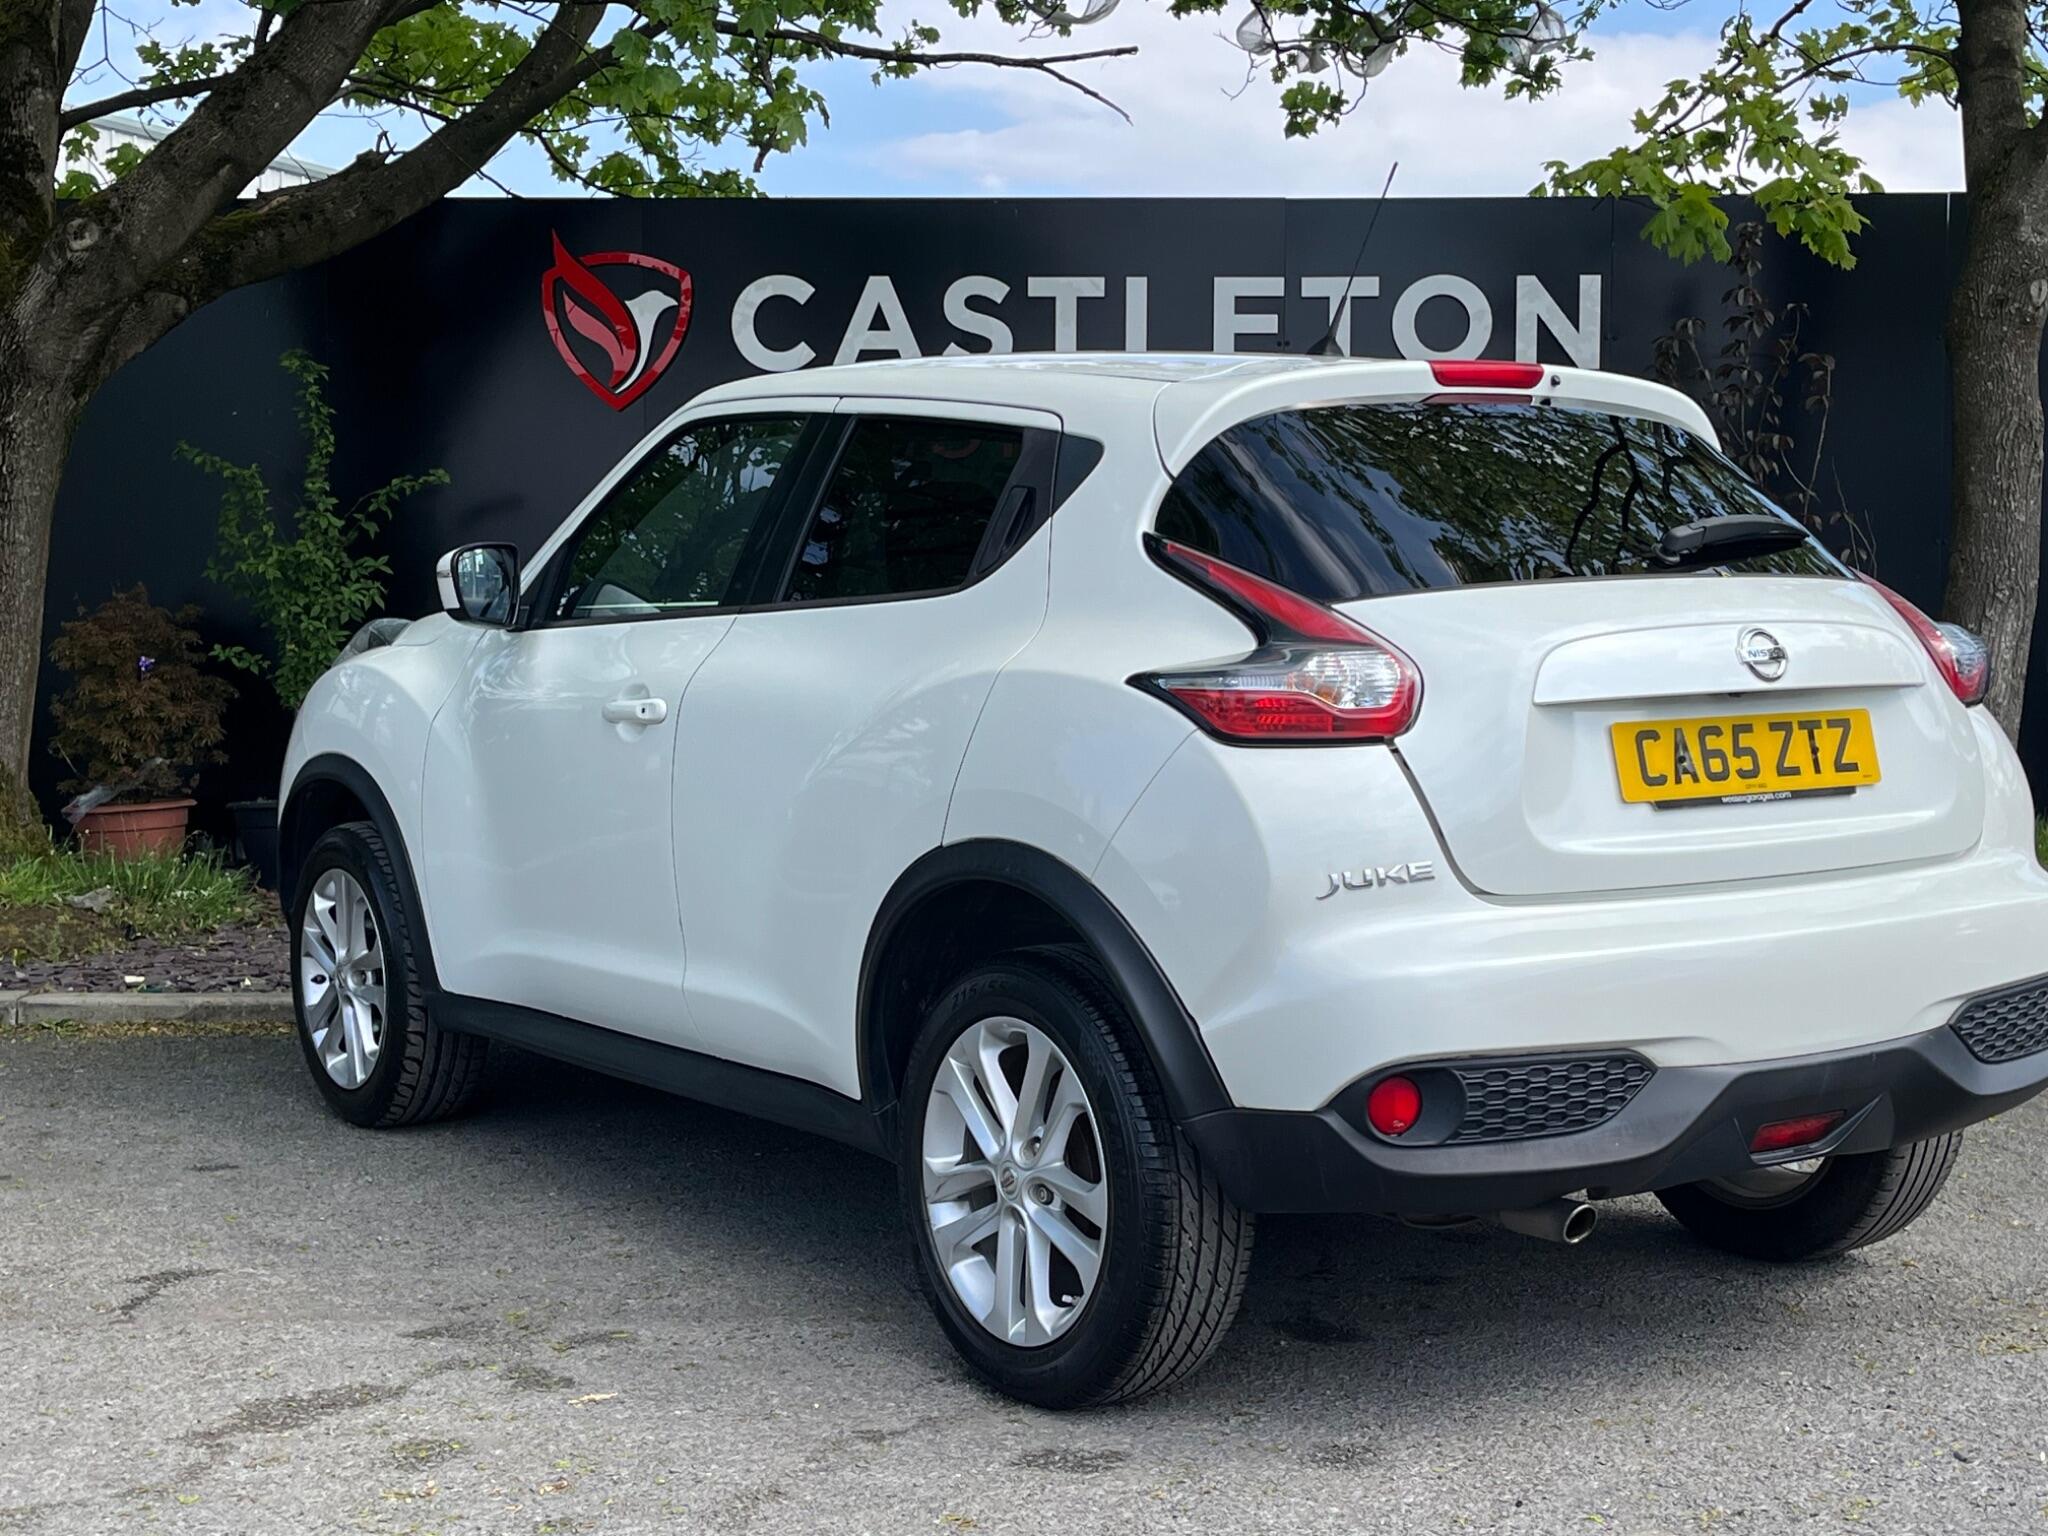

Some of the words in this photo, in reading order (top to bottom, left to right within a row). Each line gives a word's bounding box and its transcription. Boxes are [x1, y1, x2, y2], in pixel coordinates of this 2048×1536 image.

[1634, 722, 1761, 787] CA65
[1768, 717, 1860, 777] ZTZ
[1314, 860, 1436, 901] JUKE
